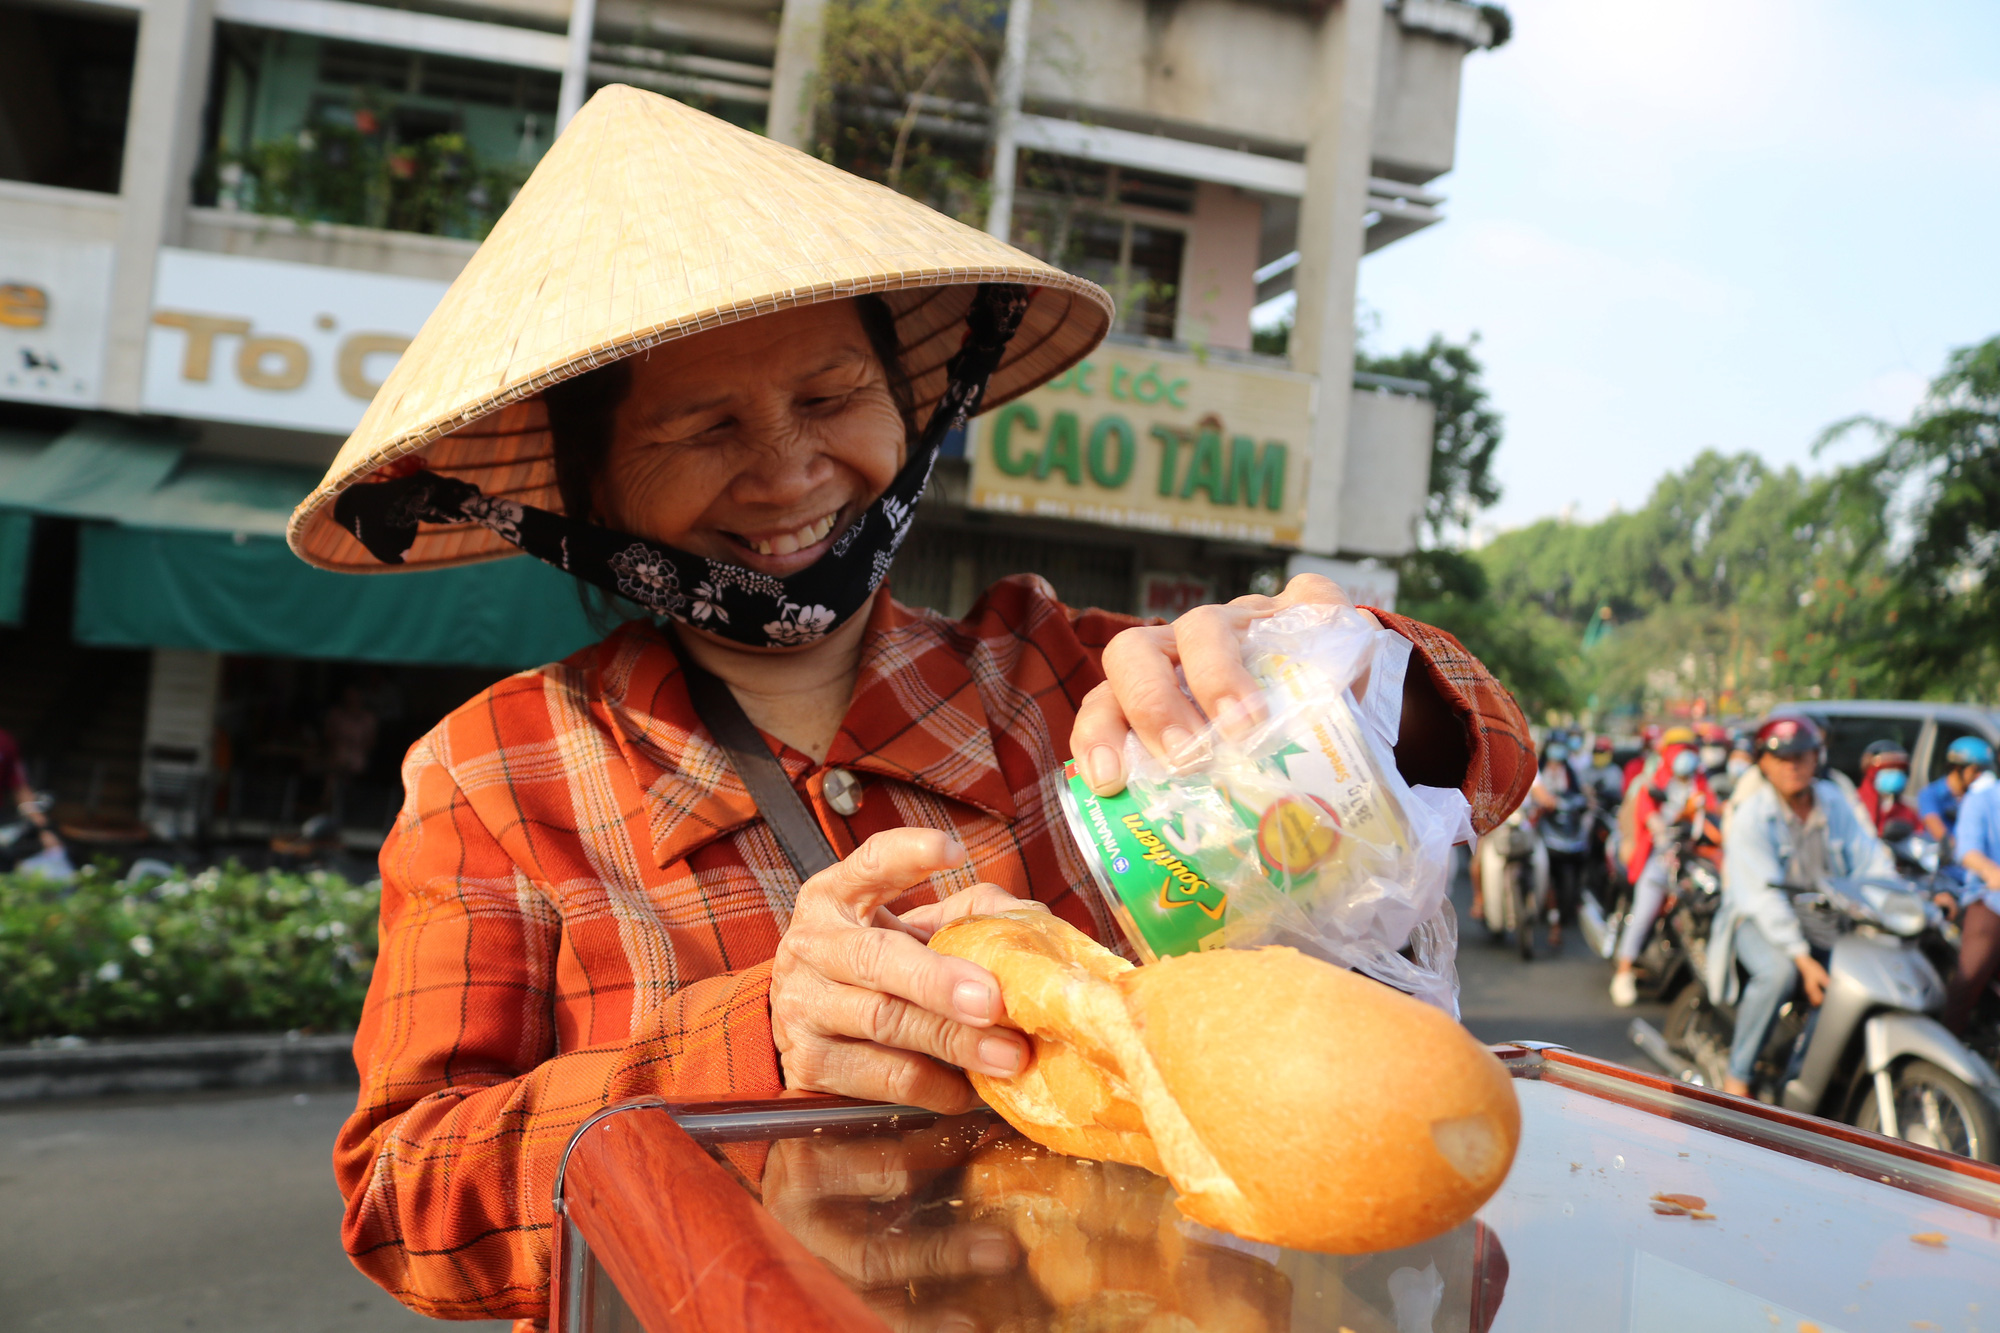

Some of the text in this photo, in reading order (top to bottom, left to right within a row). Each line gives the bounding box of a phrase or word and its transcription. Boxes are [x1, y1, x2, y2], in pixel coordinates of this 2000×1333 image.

[1111, 360, 1190, 408] tóc
[992, 403, 1288, 511] CAO TÂM
[1084, 795, 1121, 860] VINAMILK
[1121, 813, 1210, 896] Southern
